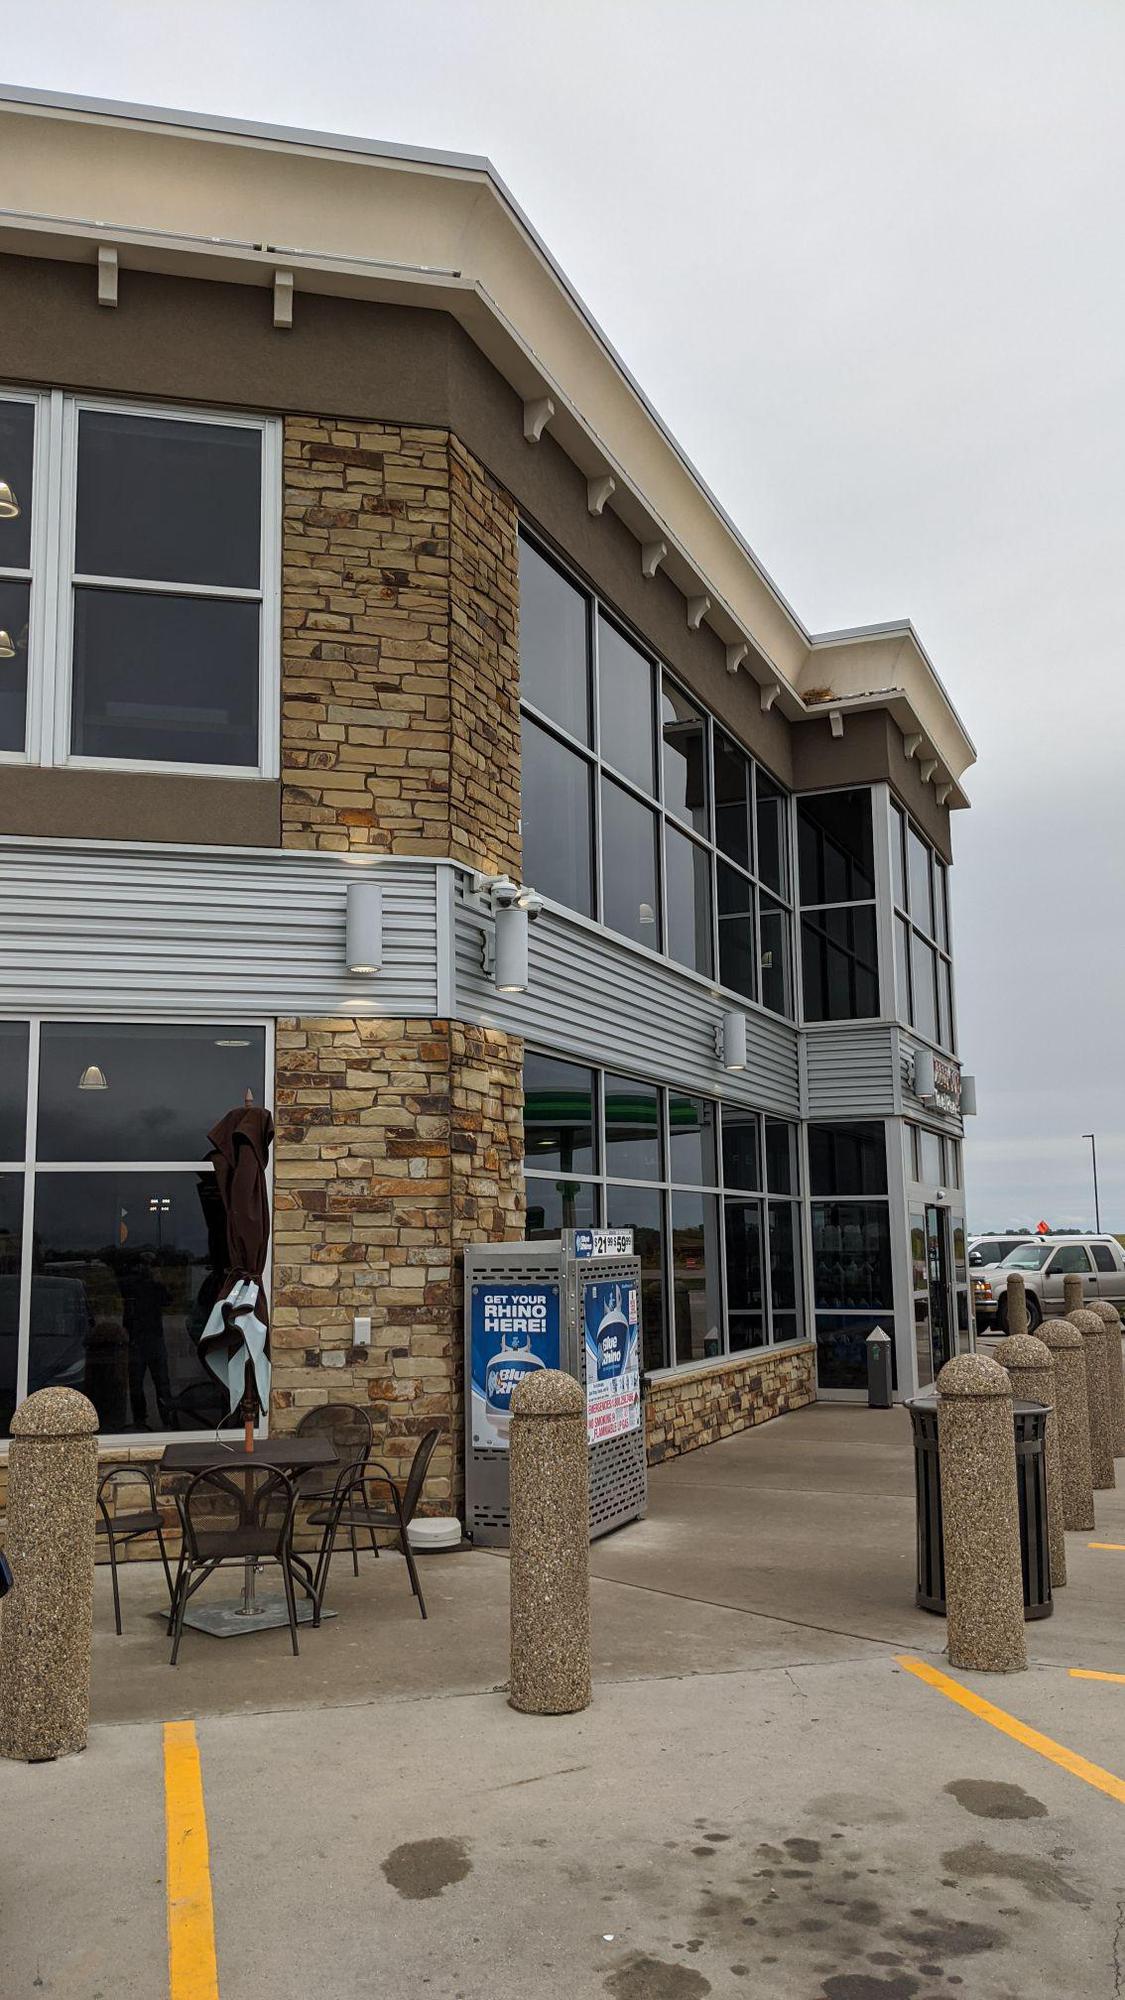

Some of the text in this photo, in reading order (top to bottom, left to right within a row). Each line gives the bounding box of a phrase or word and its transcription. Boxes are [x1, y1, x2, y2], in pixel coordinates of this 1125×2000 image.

[484, 1295, 546, 1304] GET YOUR
[484, 1305, 547, 1318] RHINO
[484, 1319, 547, 1333] HERE!
[602, 1336, 618, 1351] Blue
[594, 1412, 612, 1428] SMOKING
